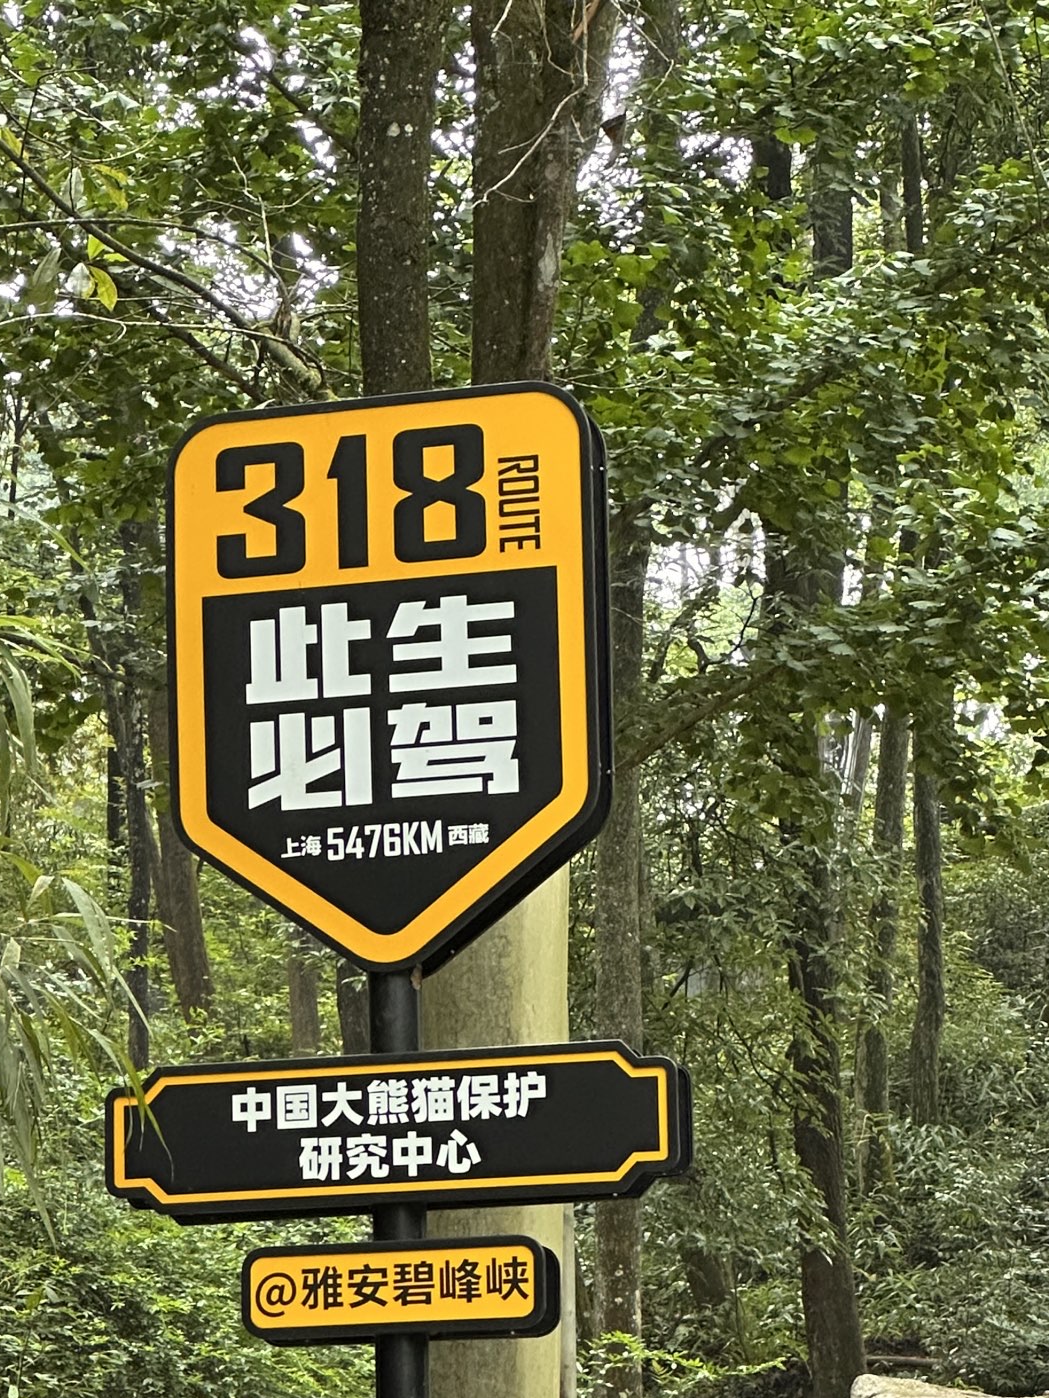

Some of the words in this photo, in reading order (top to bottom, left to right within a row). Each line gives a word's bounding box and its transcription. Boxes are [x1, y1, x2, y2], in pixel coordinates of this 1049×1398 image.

[215, 423, 487, 579] 318
[497, 454, 541, 553] ROUTE
[246, 595, 517, 704] 此生
[248, 700, 519, 811] 必驾
[280, 835, 321, 859] 上海
[326, 820, 443, 862] 5476KM
[448, 822, 489, 846] 西藏
[231, 1071, 547, 1132] 中国大熊猫保护
[299, 1129, 481, 1181] 研究中心
[256, 1255, 529, 1318] @雅安碧峰峡
